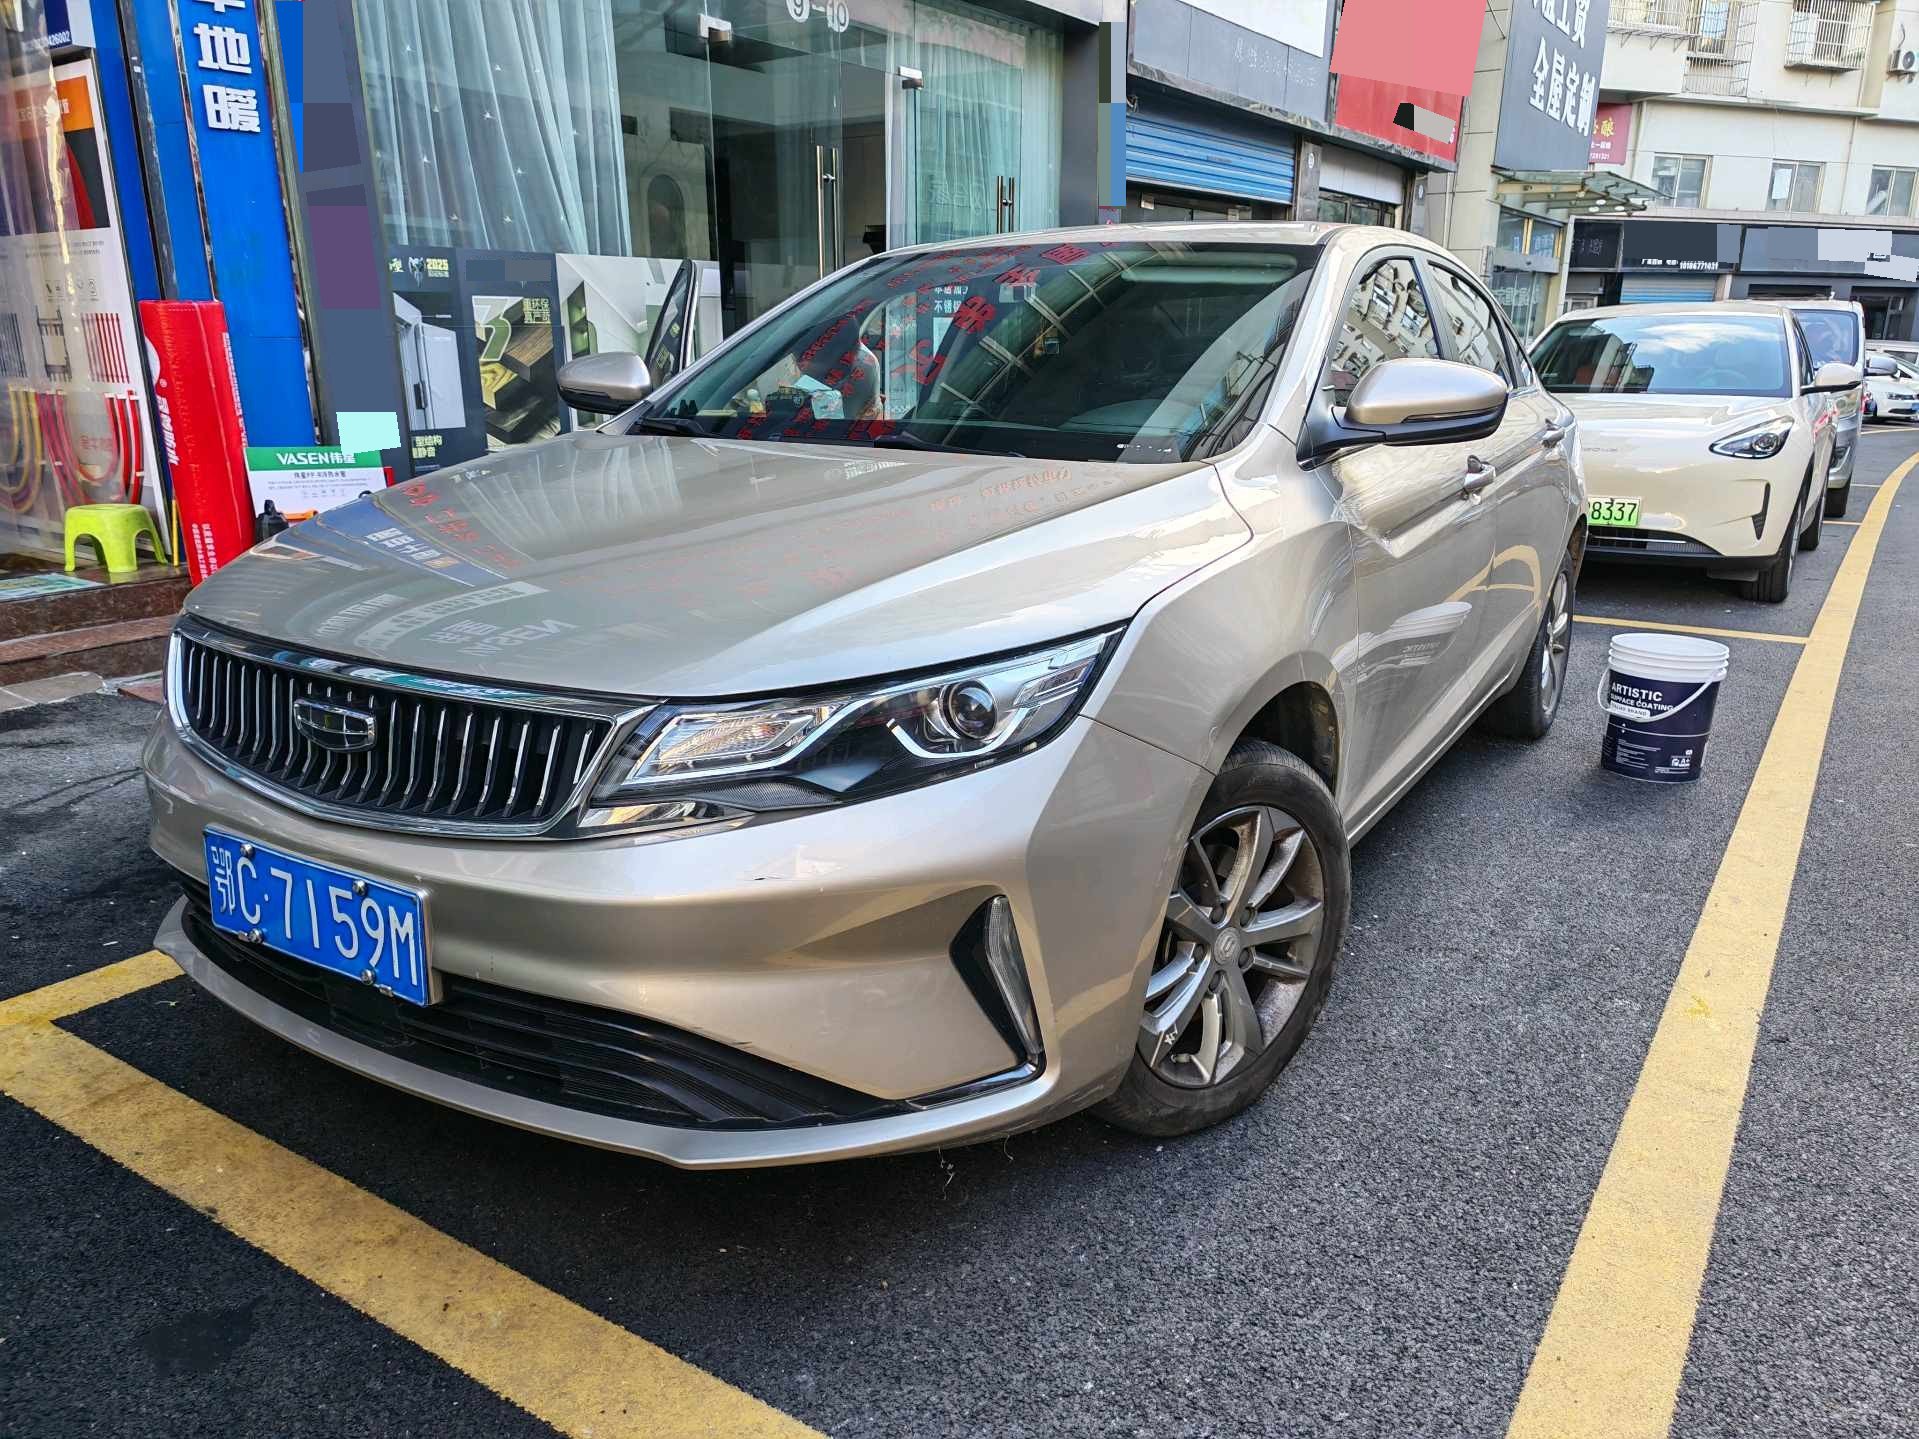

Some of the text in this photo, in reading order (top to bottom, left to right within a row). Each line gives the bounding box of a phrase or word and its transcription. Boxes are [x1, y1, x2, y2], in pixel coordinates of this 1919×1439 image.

[191, 0, 260, 132] 地暖
[1529, 36, 1596, 137] 全屋定制
[1587, 501, 1637, 522] 8337
[1611, 682, 1663, 702] ARTISTIC
[1635, 697, 1674, 711] COATING
[211, 846, 418, 986] 鄂C·7159M
